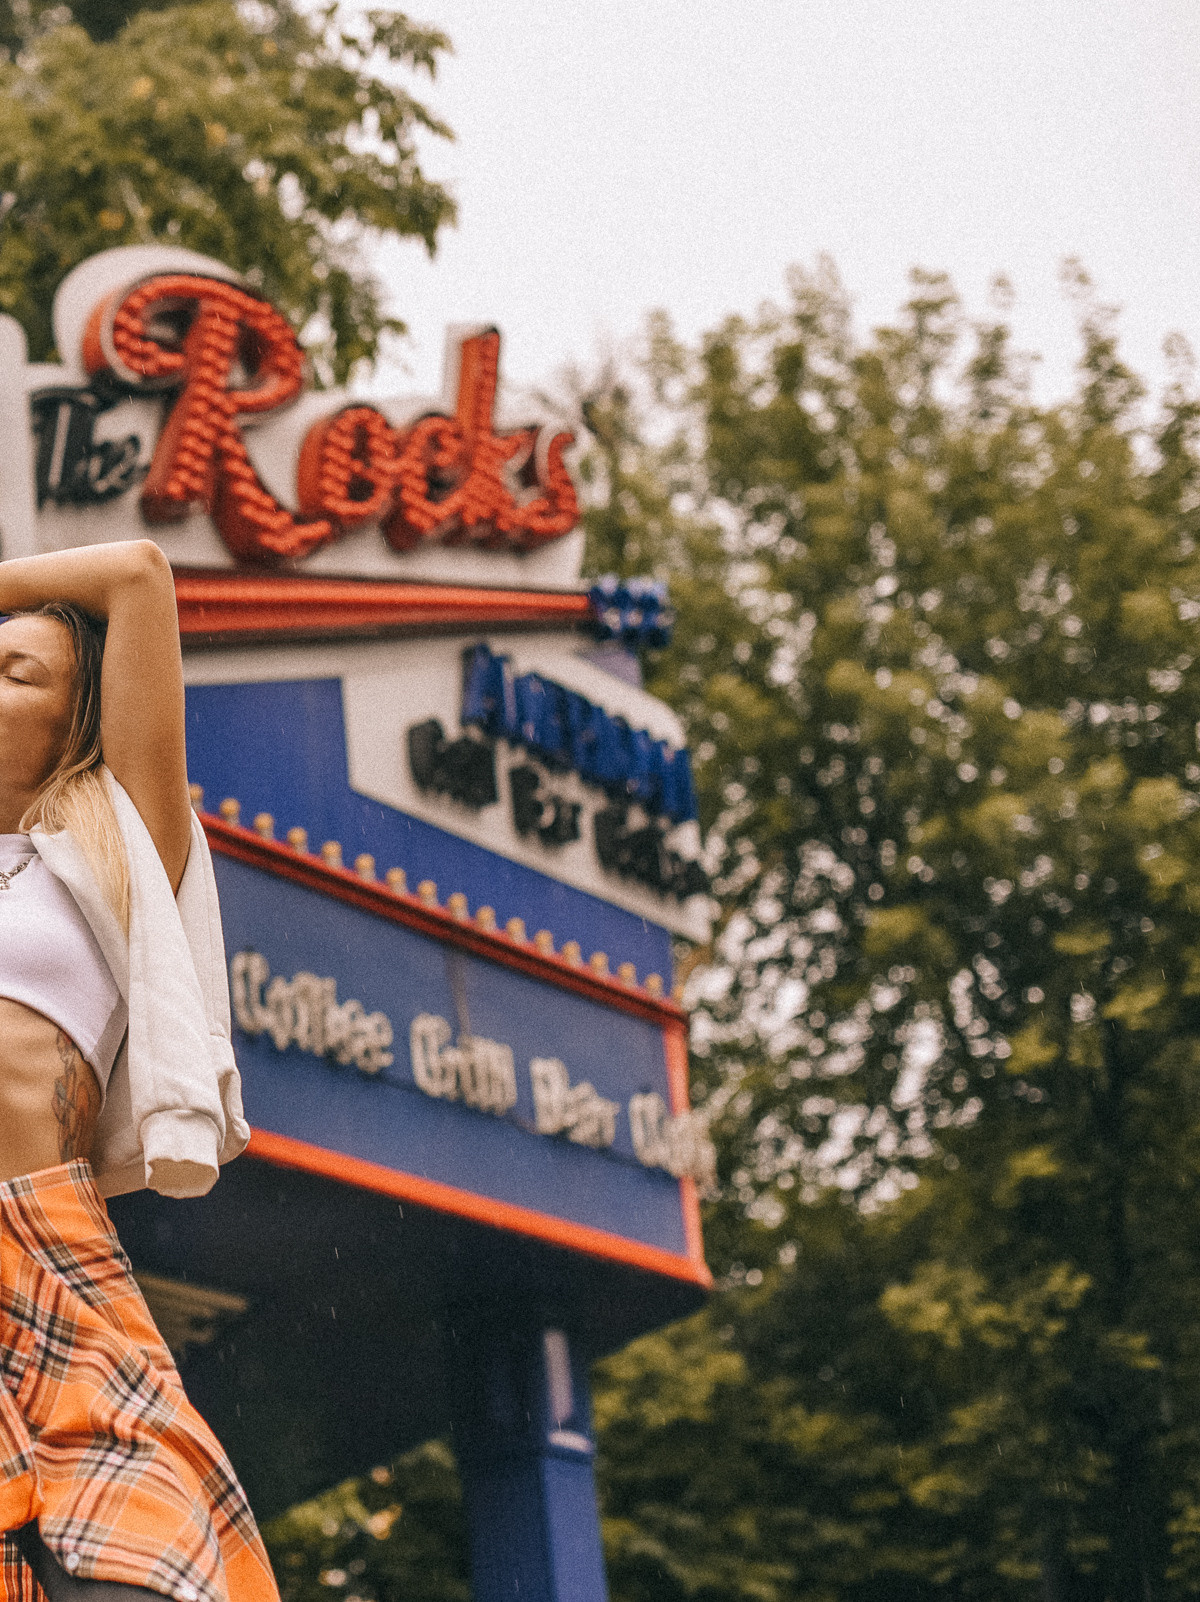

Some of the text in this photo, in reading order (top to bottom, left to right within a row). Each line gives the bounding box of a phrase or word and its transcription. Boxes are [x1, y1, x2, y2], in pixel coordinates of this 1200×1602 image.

[84, 268, 582, 560] Rocks
[231, 947, 395, 1075] Coffee
[530, 1056, 622, 1149] Bar
